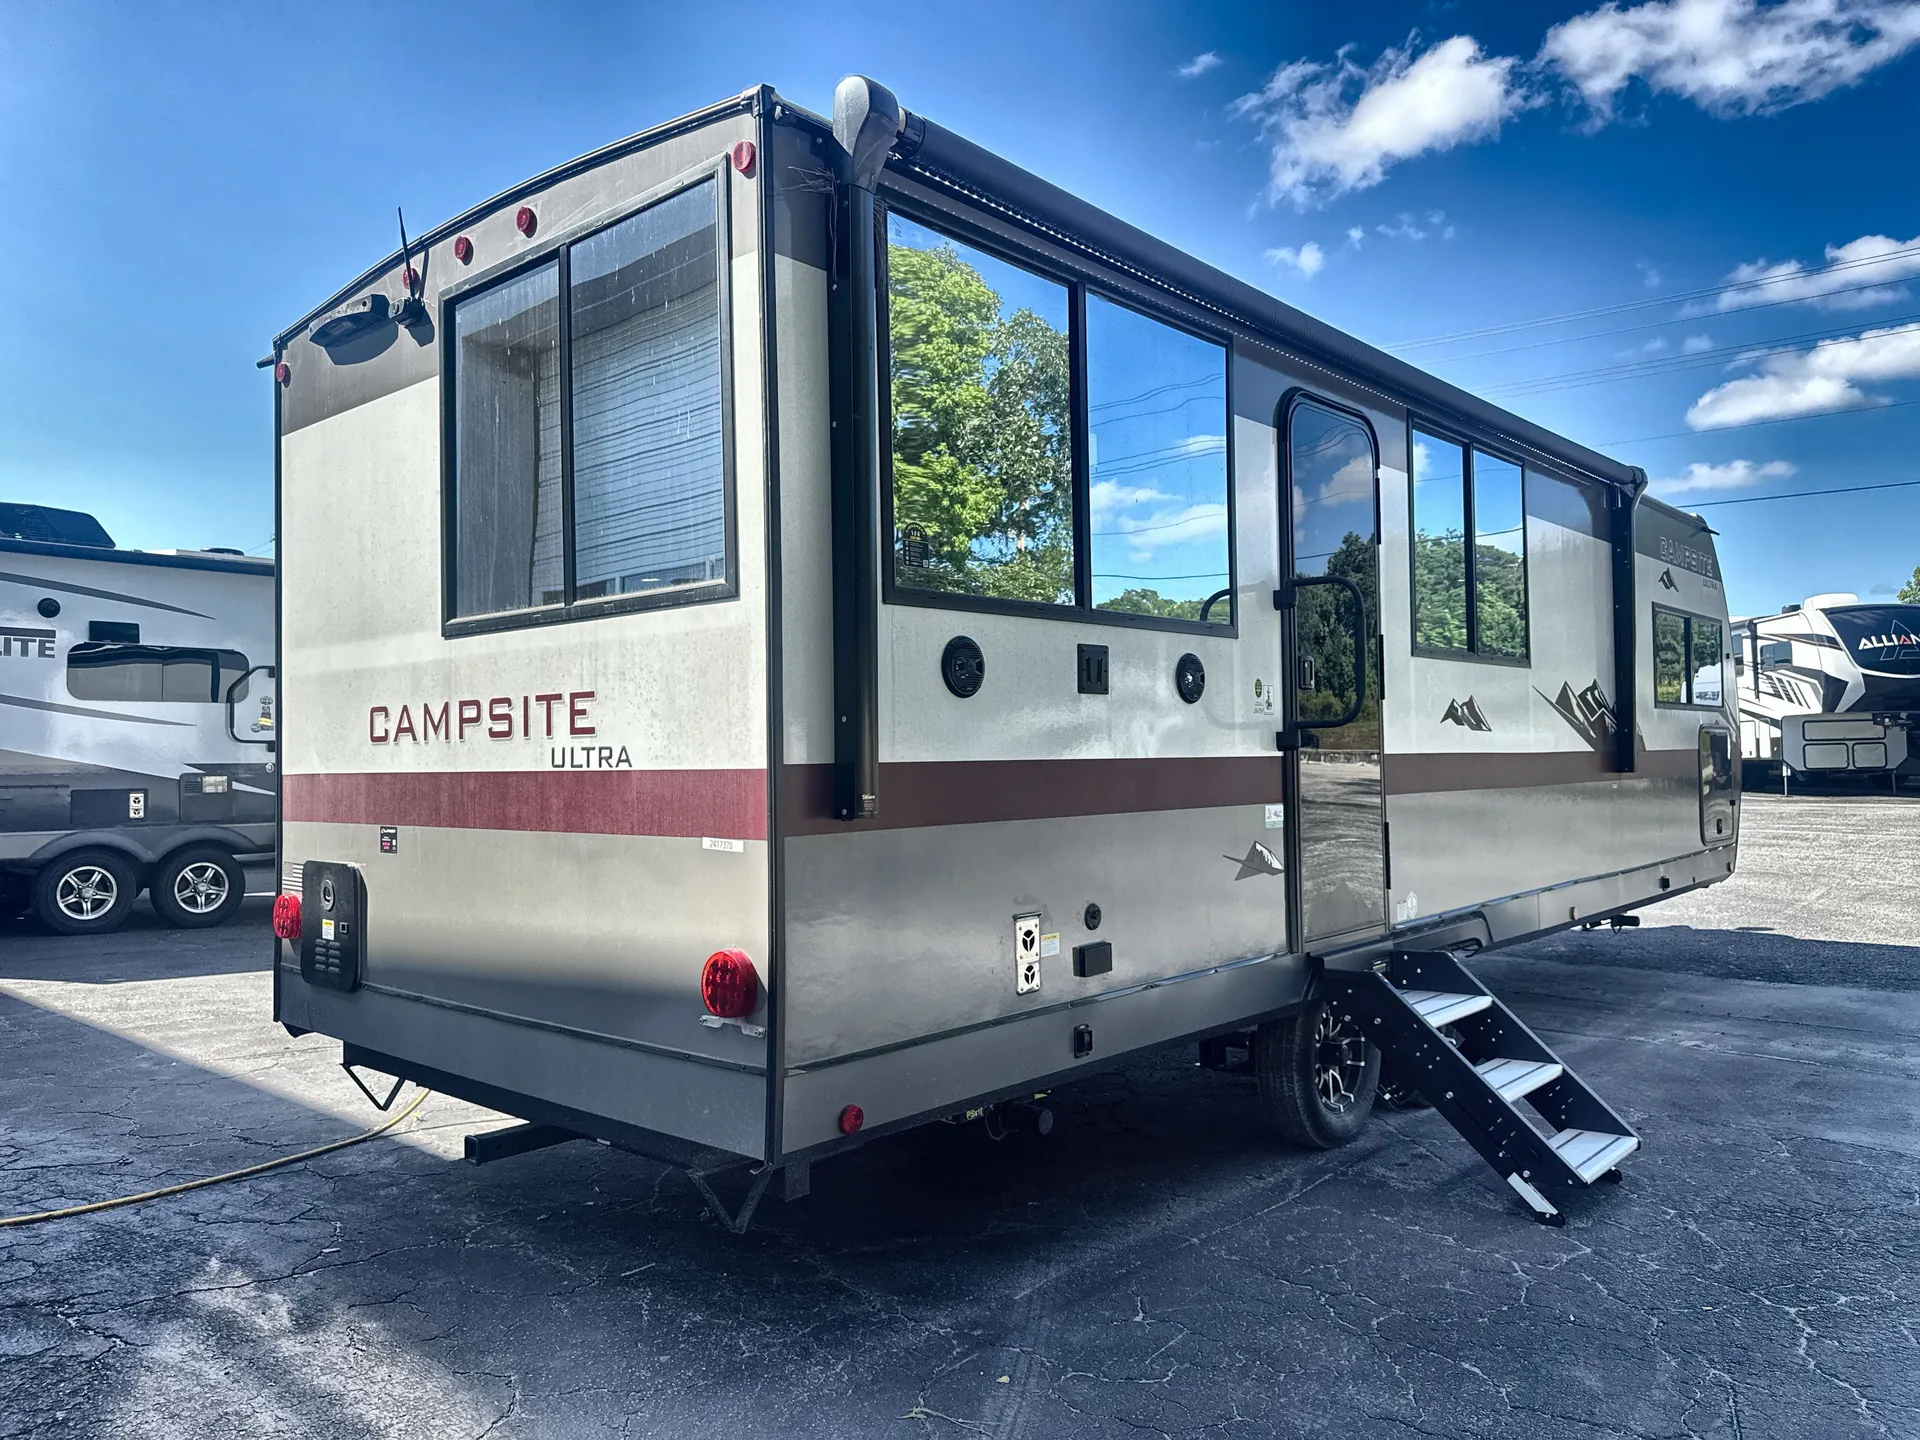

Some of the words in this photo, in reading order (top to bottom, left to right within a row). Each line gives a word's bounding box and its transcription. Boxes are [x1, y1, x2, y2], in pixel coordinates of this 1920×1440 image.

[1660, 536, 1713, 577] CAMPSITE
[1702, 578, 1718, 591] ULTRA
[0, 636, 56, 659] ITE
[369, 690, 597, 744] CAMPSITE
[551, 745, 633, 769] ULTRA
[709, 839, 733, 850] 2417370
